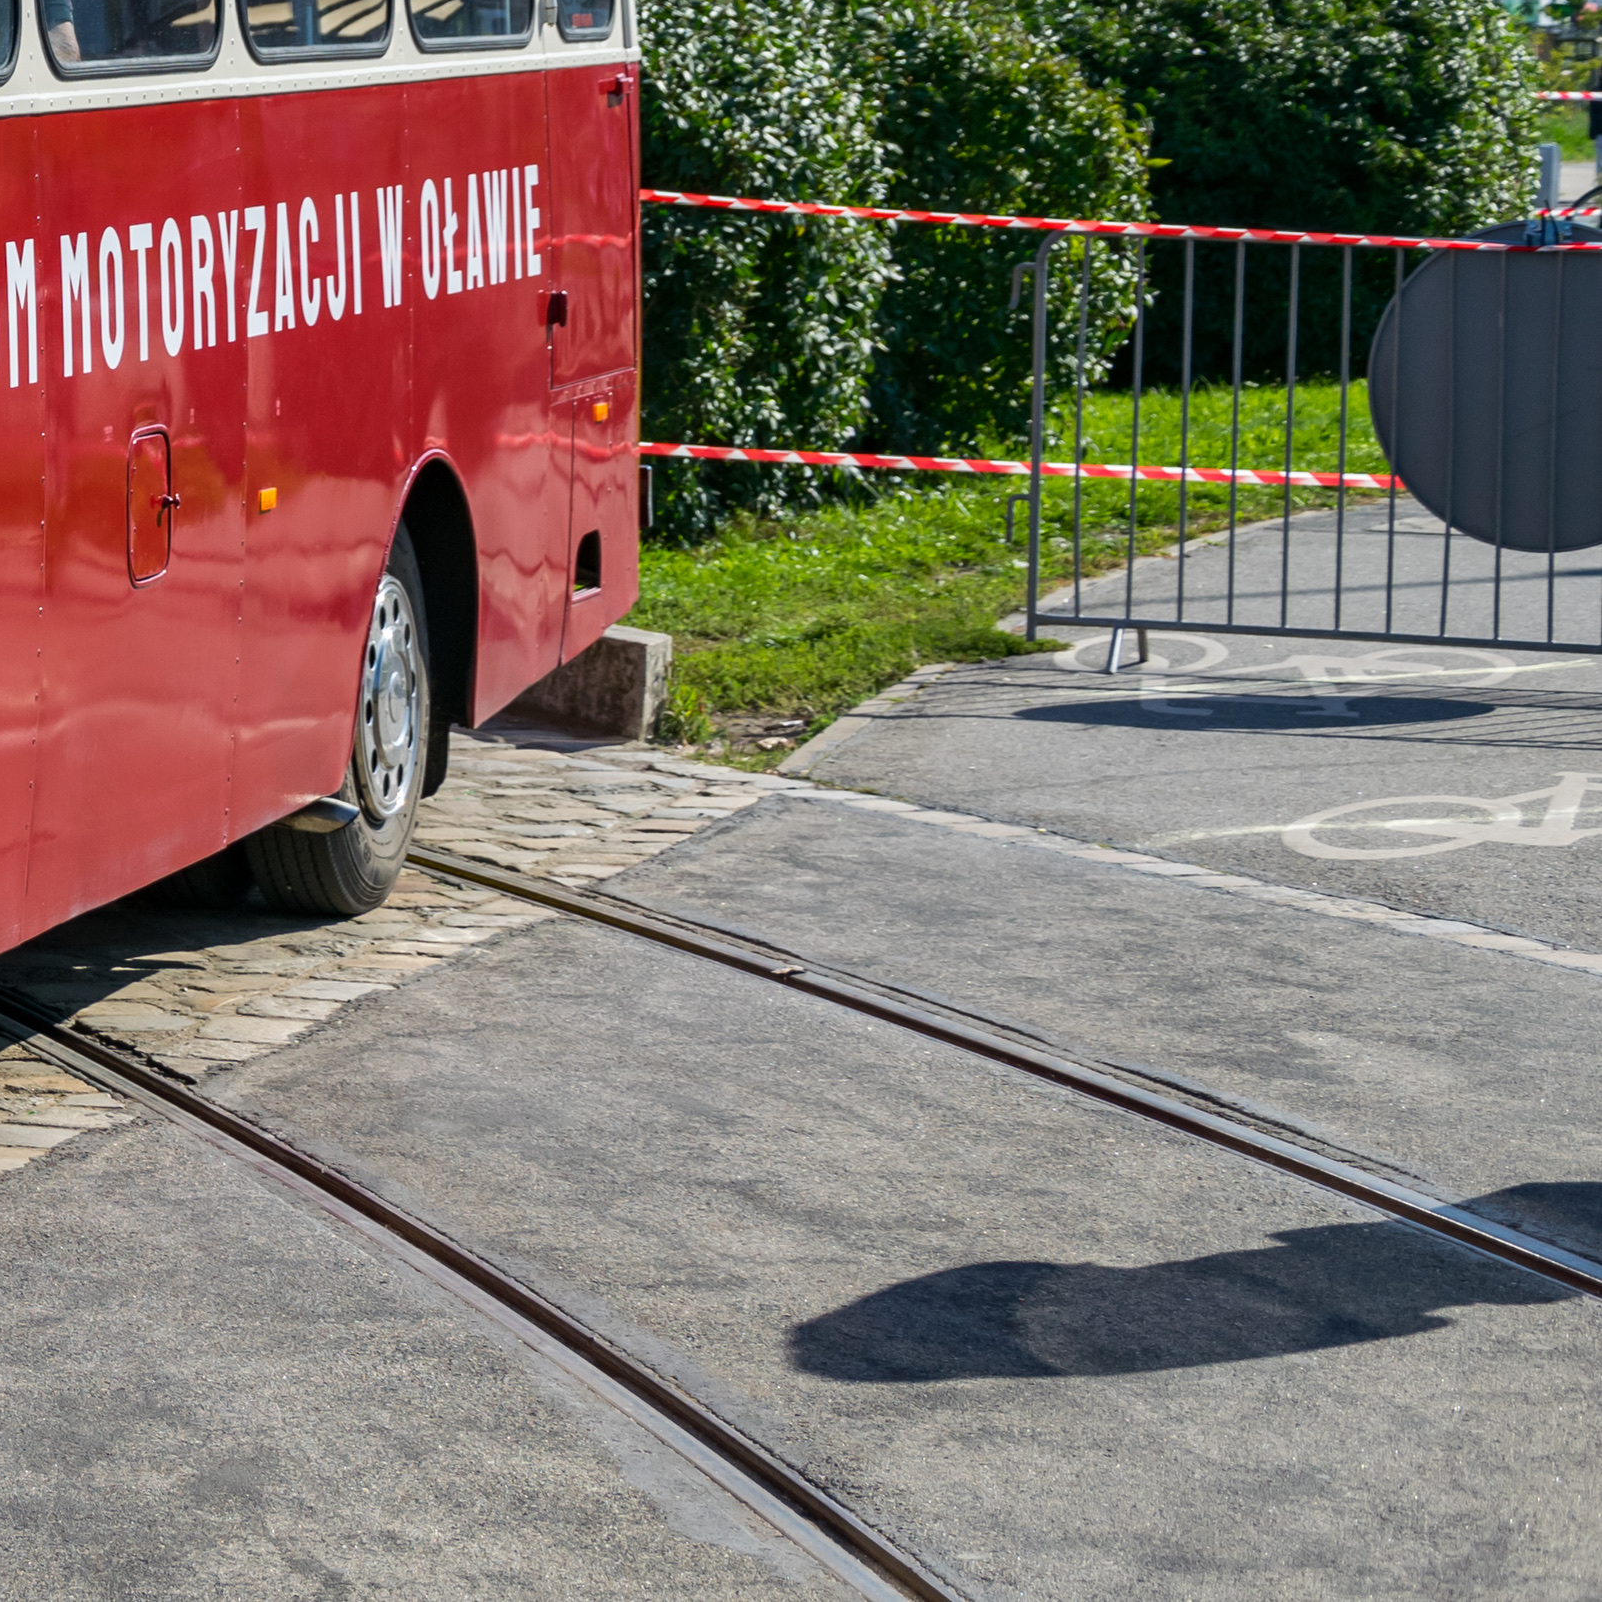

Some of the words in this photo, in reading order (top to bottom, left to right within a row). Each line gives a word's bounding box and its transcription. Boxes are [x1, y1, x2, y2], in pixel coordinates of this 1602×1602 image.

[60, 191, 363, 378] MOTORYZACJI
[375, 184, 404, 309] W
[419, 164, 542, 301] OŁAWIE
